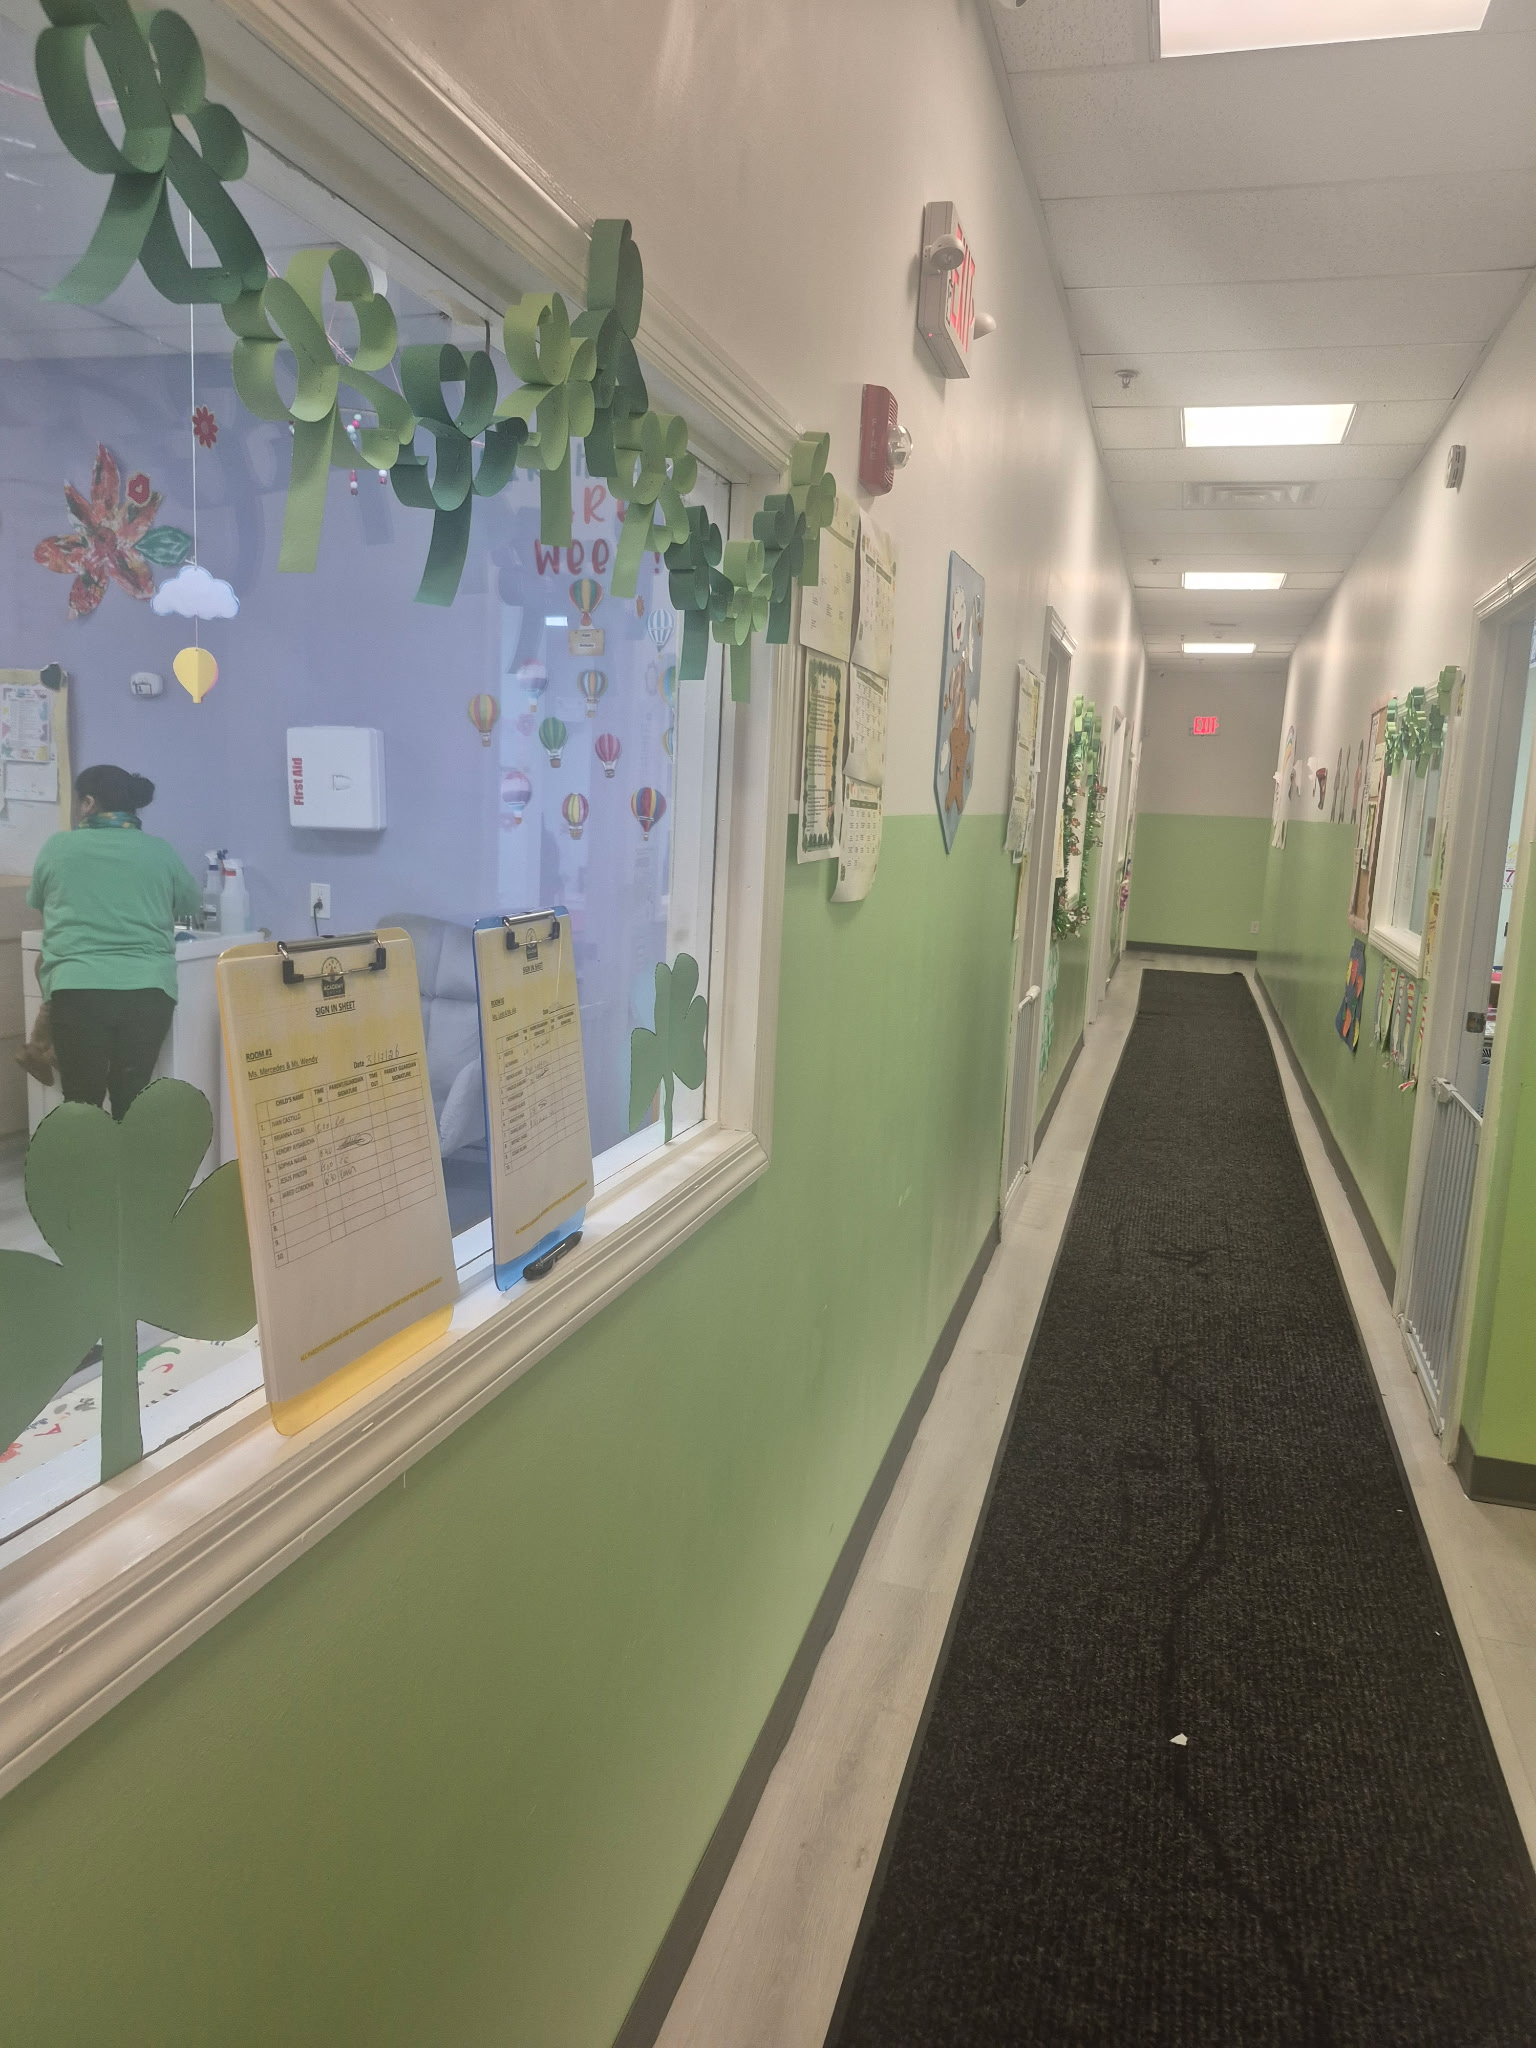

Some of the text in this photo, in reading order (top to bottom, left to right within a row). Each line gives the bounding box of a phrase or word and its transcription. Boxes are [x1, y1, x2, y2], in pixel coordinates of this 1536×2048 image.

[1193, 716, 1217, 735] EXIT
[291, 757, 304, 805] First Aid
[315, 1005, 330, 1016] SIGN
[338, 1000, 355, 1011] SHEET
[245, 1050, 265, 1061] ROOM
[259, 1062, 286, 1076] Mercedes
[300, 1055, 319, 1066] Wendy
[353, 1060, 365, 1070] Date
